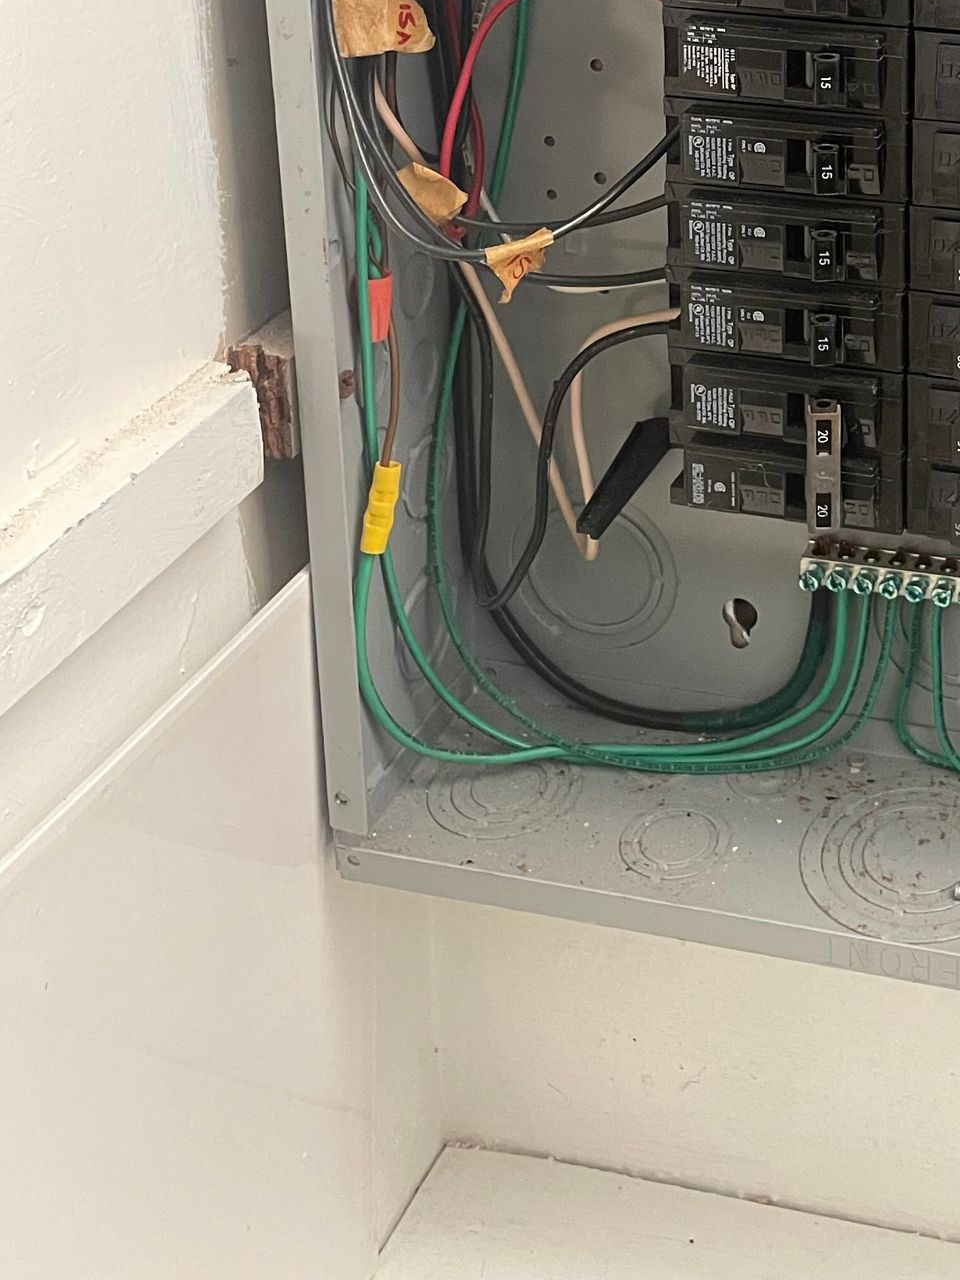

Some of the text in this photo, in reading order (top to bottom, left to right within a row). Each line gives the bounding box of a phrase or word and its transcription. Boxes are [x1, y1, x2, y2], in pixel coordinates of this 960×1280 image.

[820, 76, 832, 90] 15
[821, 164, 833, 179] 15
[818, 250, 830, 265] 15
[818, 337, 829, 351] 15
[817, 429, 828, 443] 20
[817, 505, 828, 517] 20
[821, 936, 960, 988] FRONT
